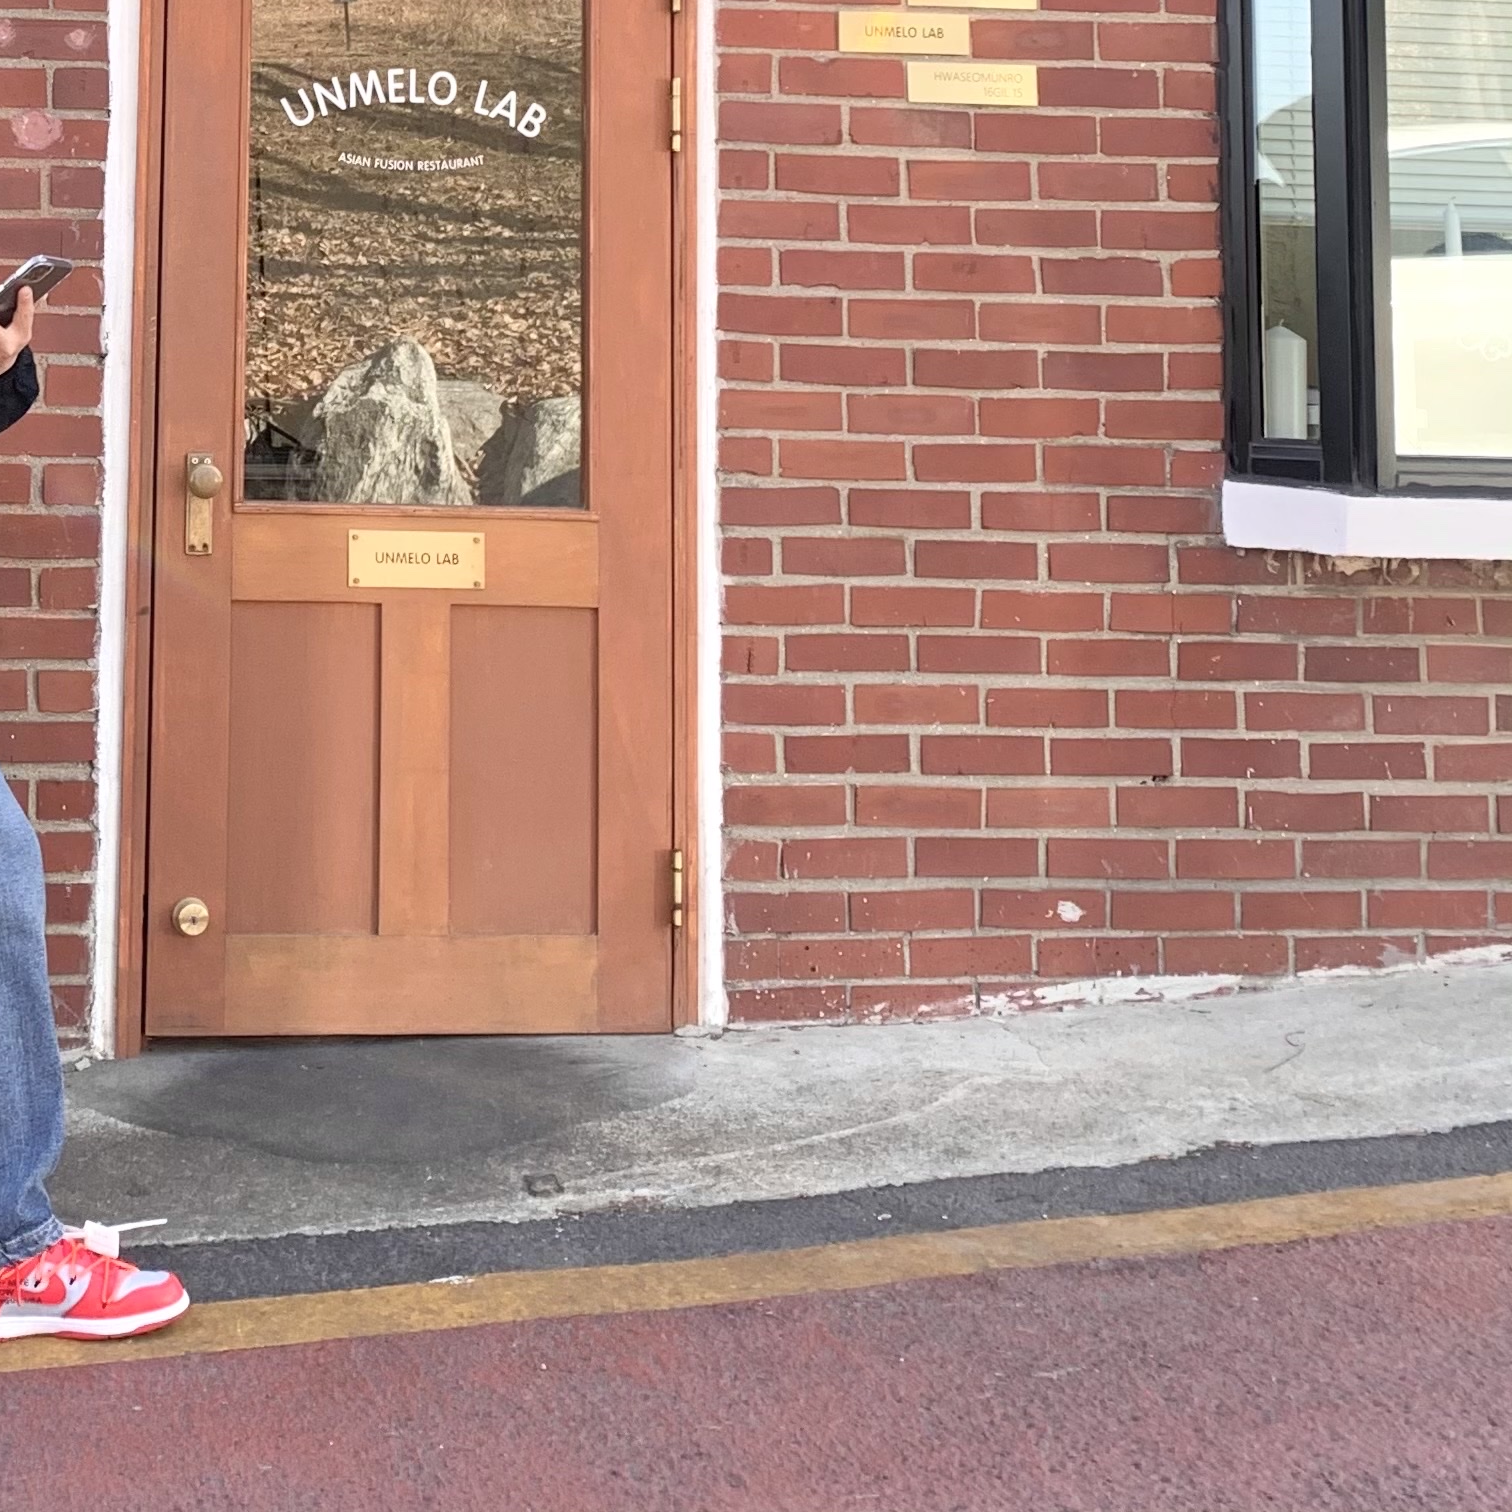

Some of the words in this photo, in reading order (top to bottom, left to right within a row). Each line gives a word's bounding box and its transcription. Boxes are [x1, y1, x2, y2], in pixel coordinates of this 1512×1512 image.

[864, 24, 918, 39] UNMELO
[922, 26, 944, 39] LAB
[279, 68, 458, 128] UNMELO
[473, 79, 548, 139] LAB
[337, 152, 371, 168] ASIAN
[374, 157, 414, 171] FUSION
[417, 154, 485, 172] RESTAURANT
[375, 551, 431, 564] UNMELO
[436, 553, 460, 565] LAB
